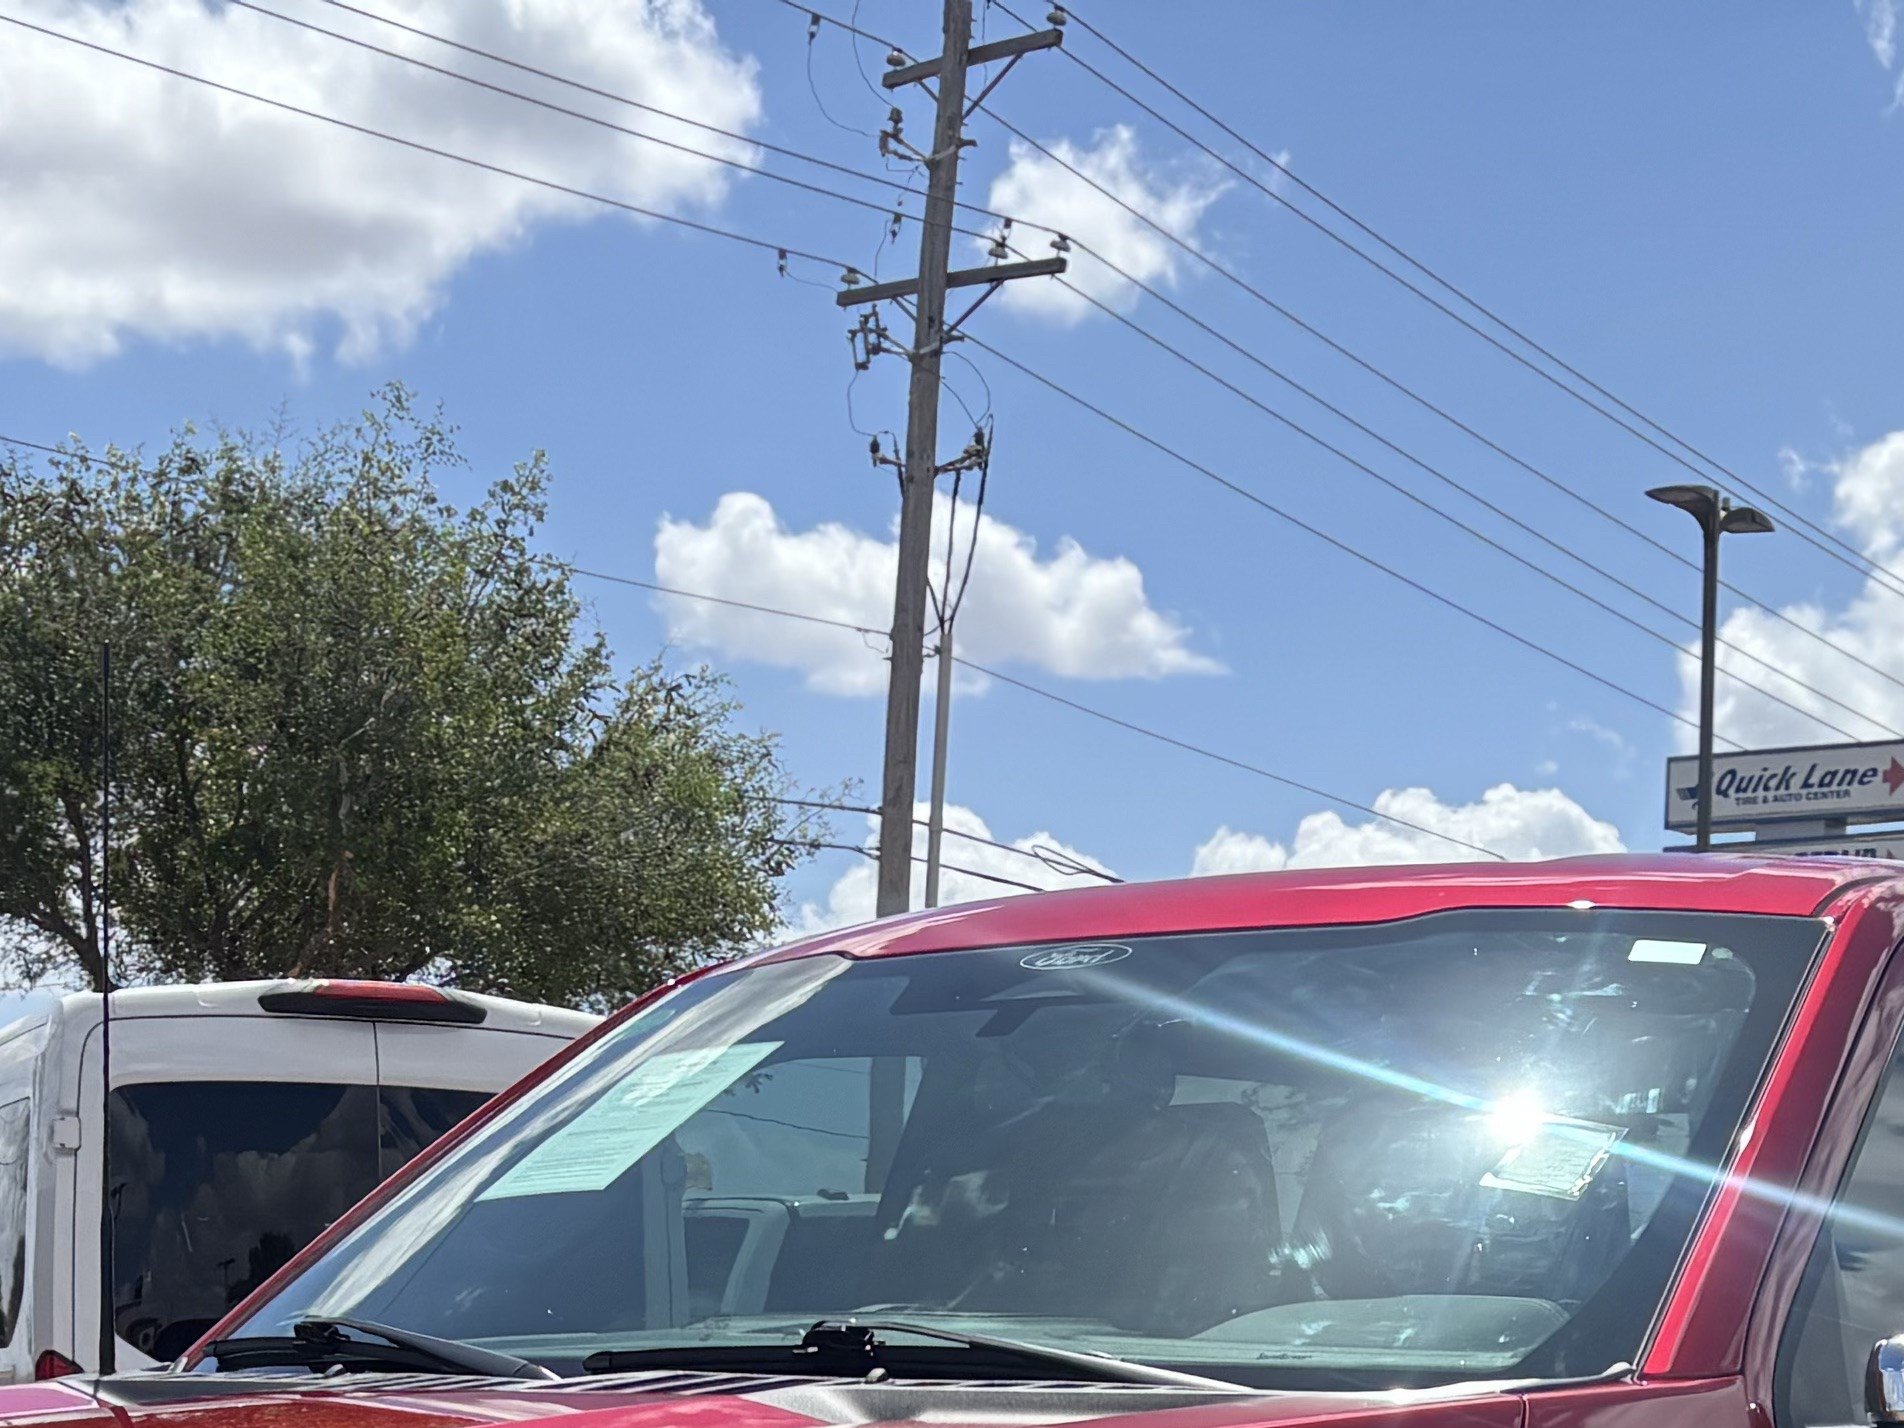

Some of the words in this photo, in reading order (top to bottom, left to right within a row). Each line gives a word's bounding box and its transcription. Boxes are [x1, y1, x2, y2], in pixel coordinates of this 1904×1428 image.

[1715, 764, 1797, 798] Quick
[1800, 762, 1879, 790] Lane
[1805, 789, 1852, 801] CENTER
